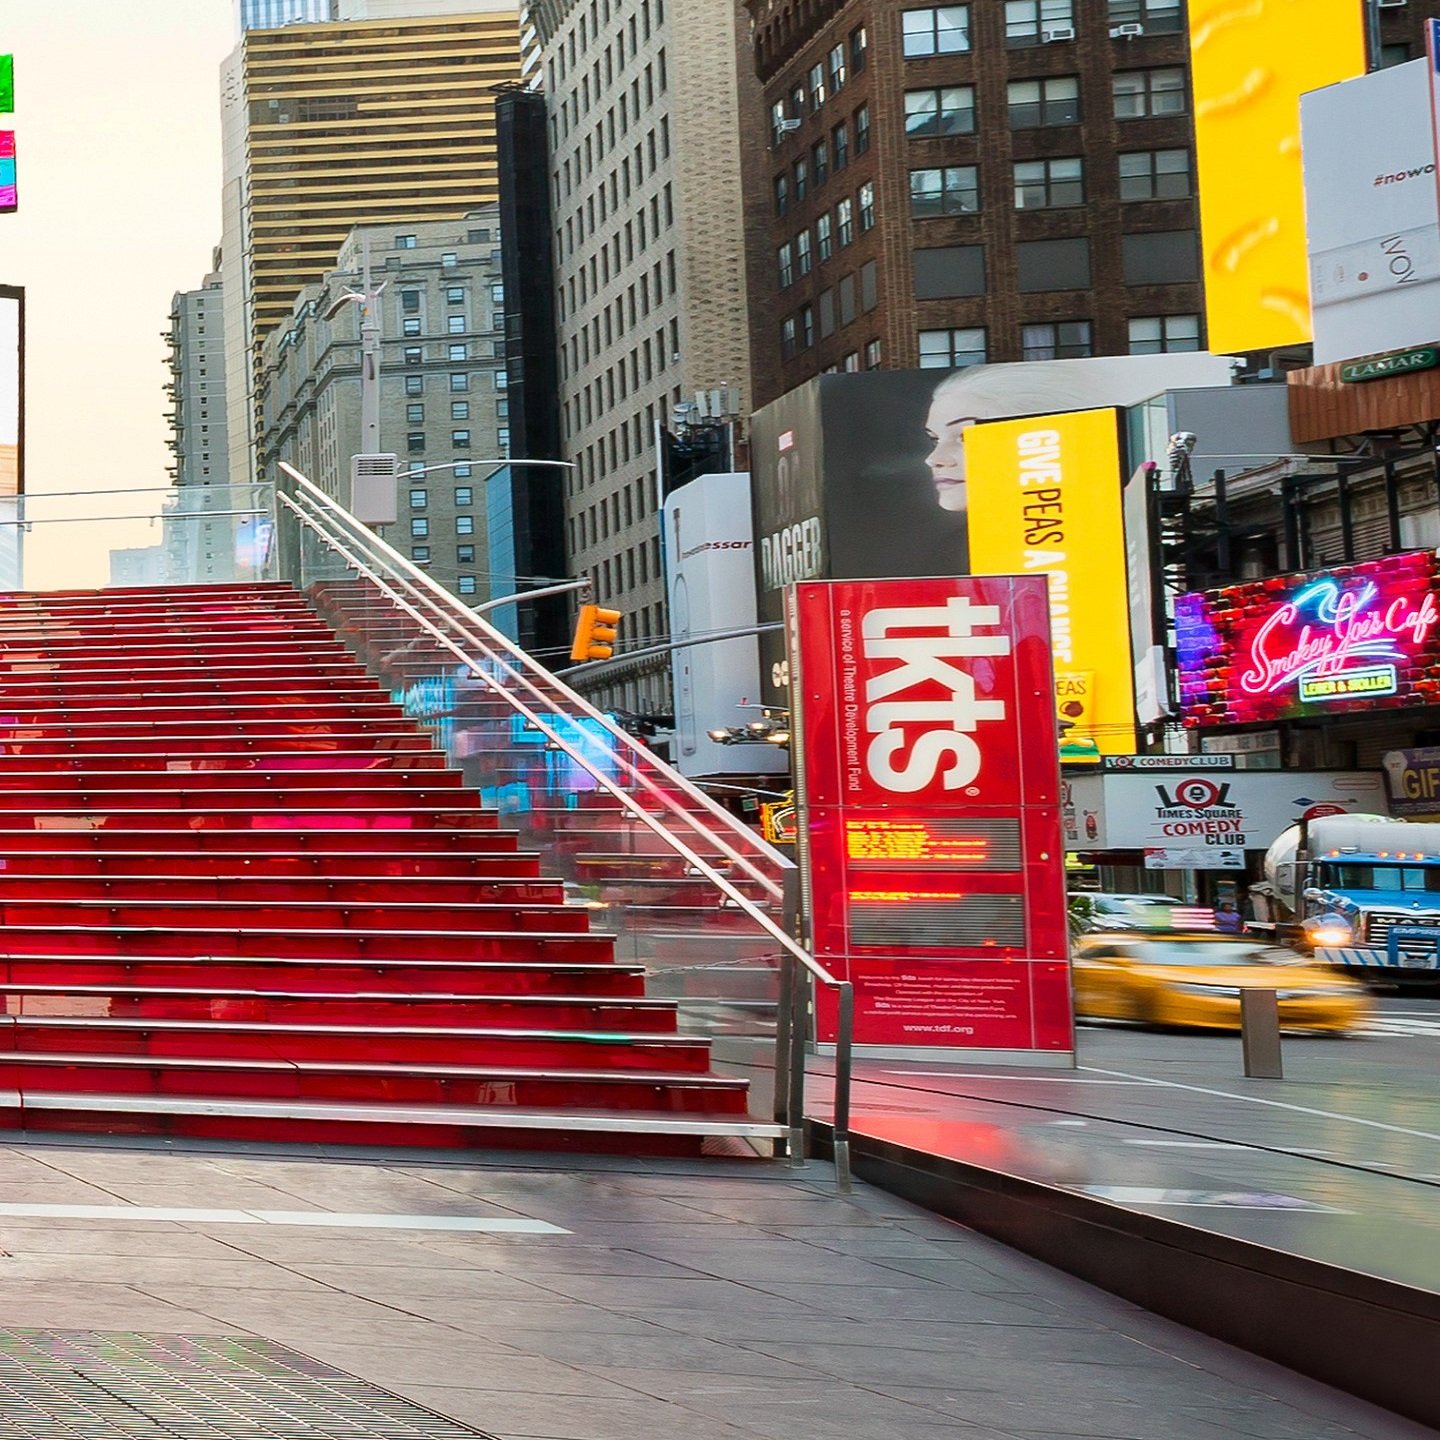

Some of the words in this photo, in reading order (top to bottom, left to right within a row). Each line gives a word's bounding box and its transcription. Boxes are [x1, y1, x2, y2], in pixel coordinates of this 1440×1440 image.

[1348, 351, 1426, 378] LAMAR
[1017, 428, 1062, 486] GIVE
[1022, 487, 1065, 546] PEAS
[761, 517, 822, 588] DAGGER
[1023, 549, 1067, 569] A
[841, 617, 854, 652] service
[1241, 603, 1331, 688] Smokey
[843, 654, 857, 664] of
[843, 665, 858, 702] Theatre
[861, 597, 1011, 794] tkts
[845, 704, 860, 766] Development
[848, 768, 863, 792] Fund
[1155, 778, 1235, 810] LOL
[1155, 807, 1193, 820] TIMES
[1195, 807, 1244, 820] SQUARE
[1163, 819, 1242, 837] COMEDY
[1205, 833, 1246, 846] CLUB
[902, 1023, 975, 1036] www.tdf.org
